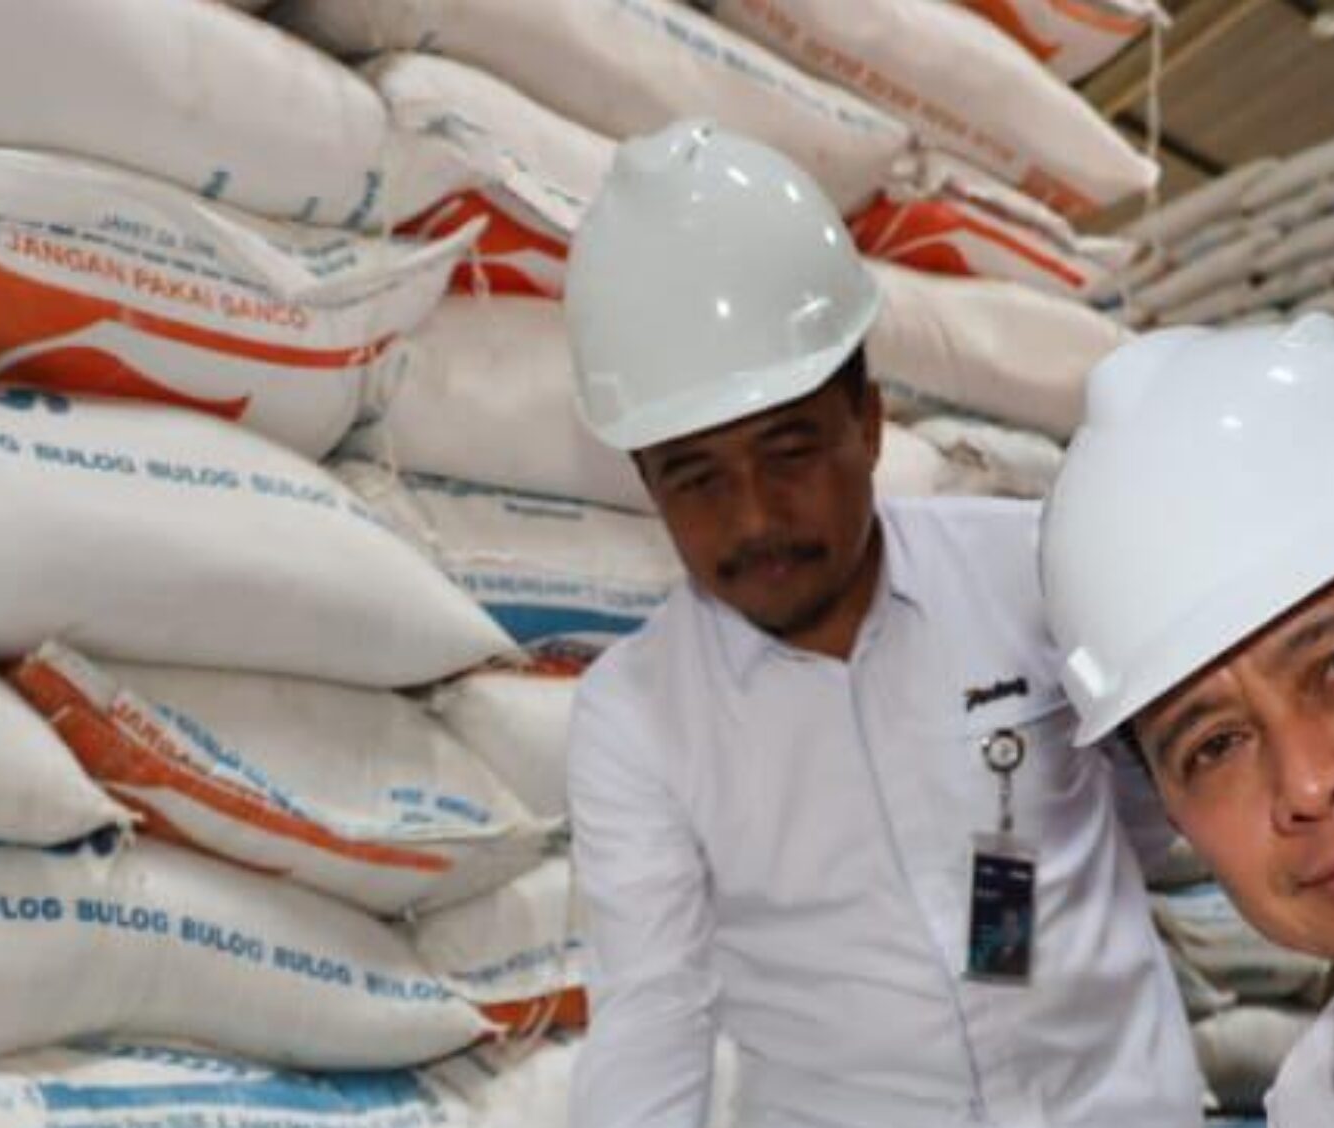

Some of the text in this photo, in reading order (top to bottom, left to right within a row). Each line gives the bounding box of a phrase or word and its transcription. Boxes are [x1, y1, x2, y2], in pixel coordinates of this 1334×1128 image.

[74, 898, 170, 937] BULOG
[180, 916, 264, 963] BULOG
[272, 945, 353, 988] BULOG
